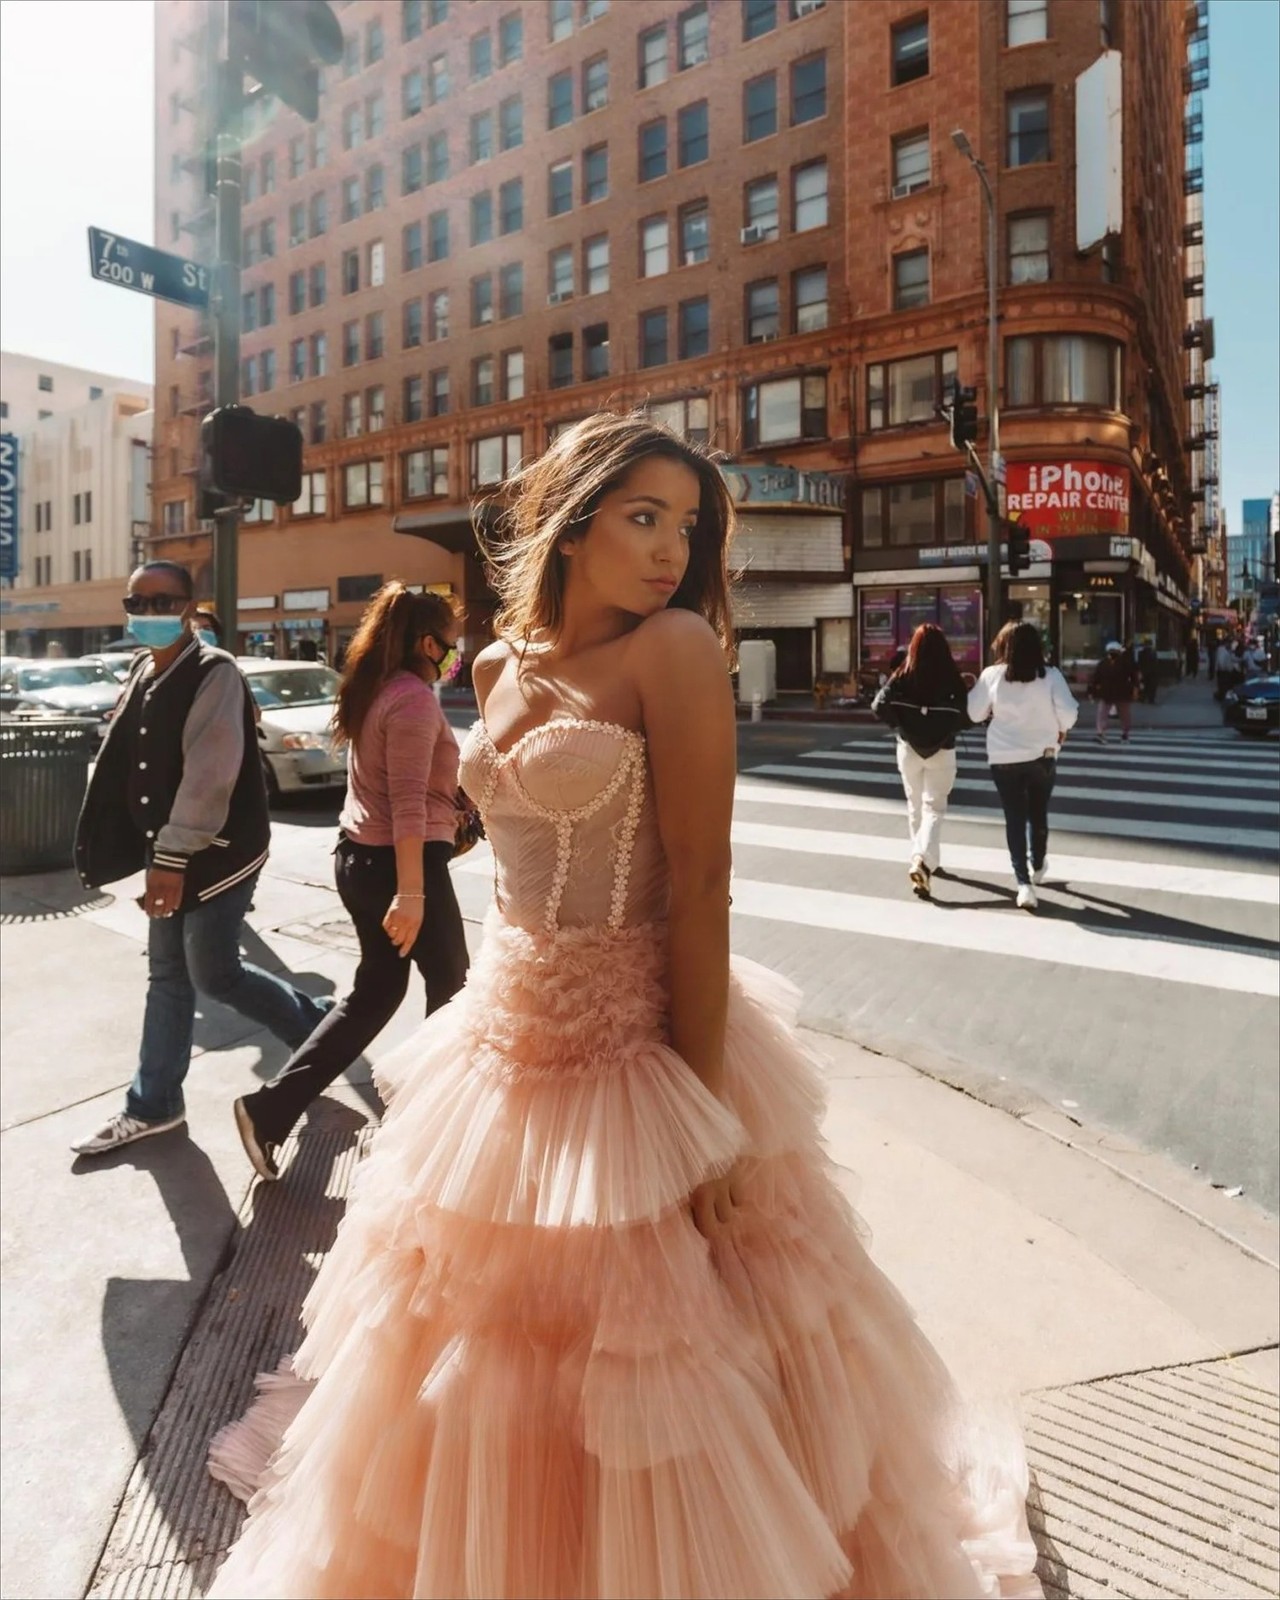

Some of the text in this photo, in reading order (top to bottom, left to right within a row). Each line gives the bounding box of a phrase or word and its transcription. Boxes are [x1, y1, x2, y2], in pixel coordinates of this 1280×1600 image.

[98, 259, 155, 291] 200 W
[99, 233, 206, 291] 7th St
[1029, 463, 1124, 496] iPhone
[1007, 491, 1081, 510] REPAIR
